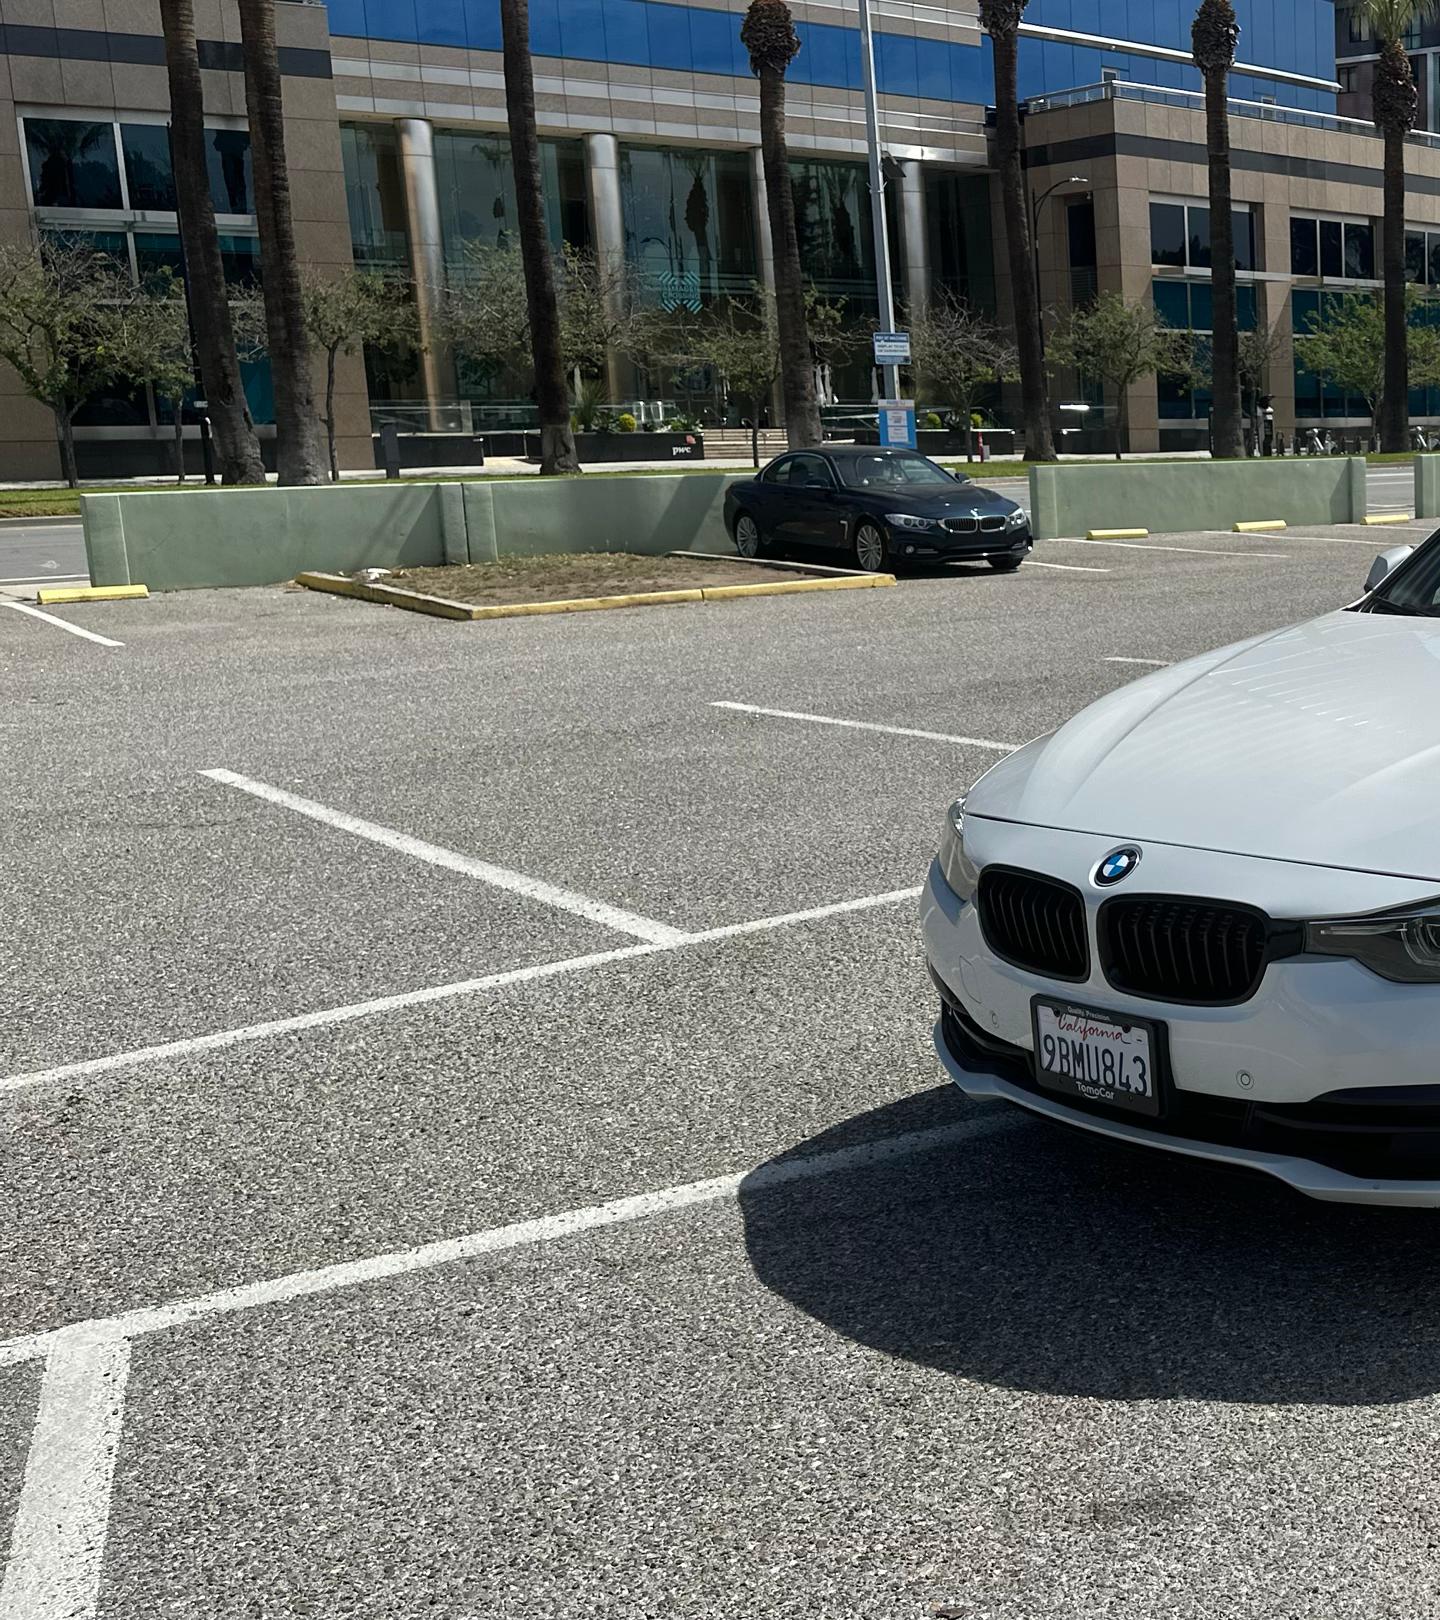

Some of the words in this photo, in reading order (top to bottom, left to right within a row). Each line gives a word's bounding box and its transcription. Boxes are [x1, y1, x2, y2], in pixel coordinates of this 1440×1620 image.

[672, 446, 691, 456] pwc
[1058, 1013, 1131, 1044] California
[1043, 1034, 1147, 1096] 9BMU843
[1075, 1081, 1114, 1100] TomoCar
